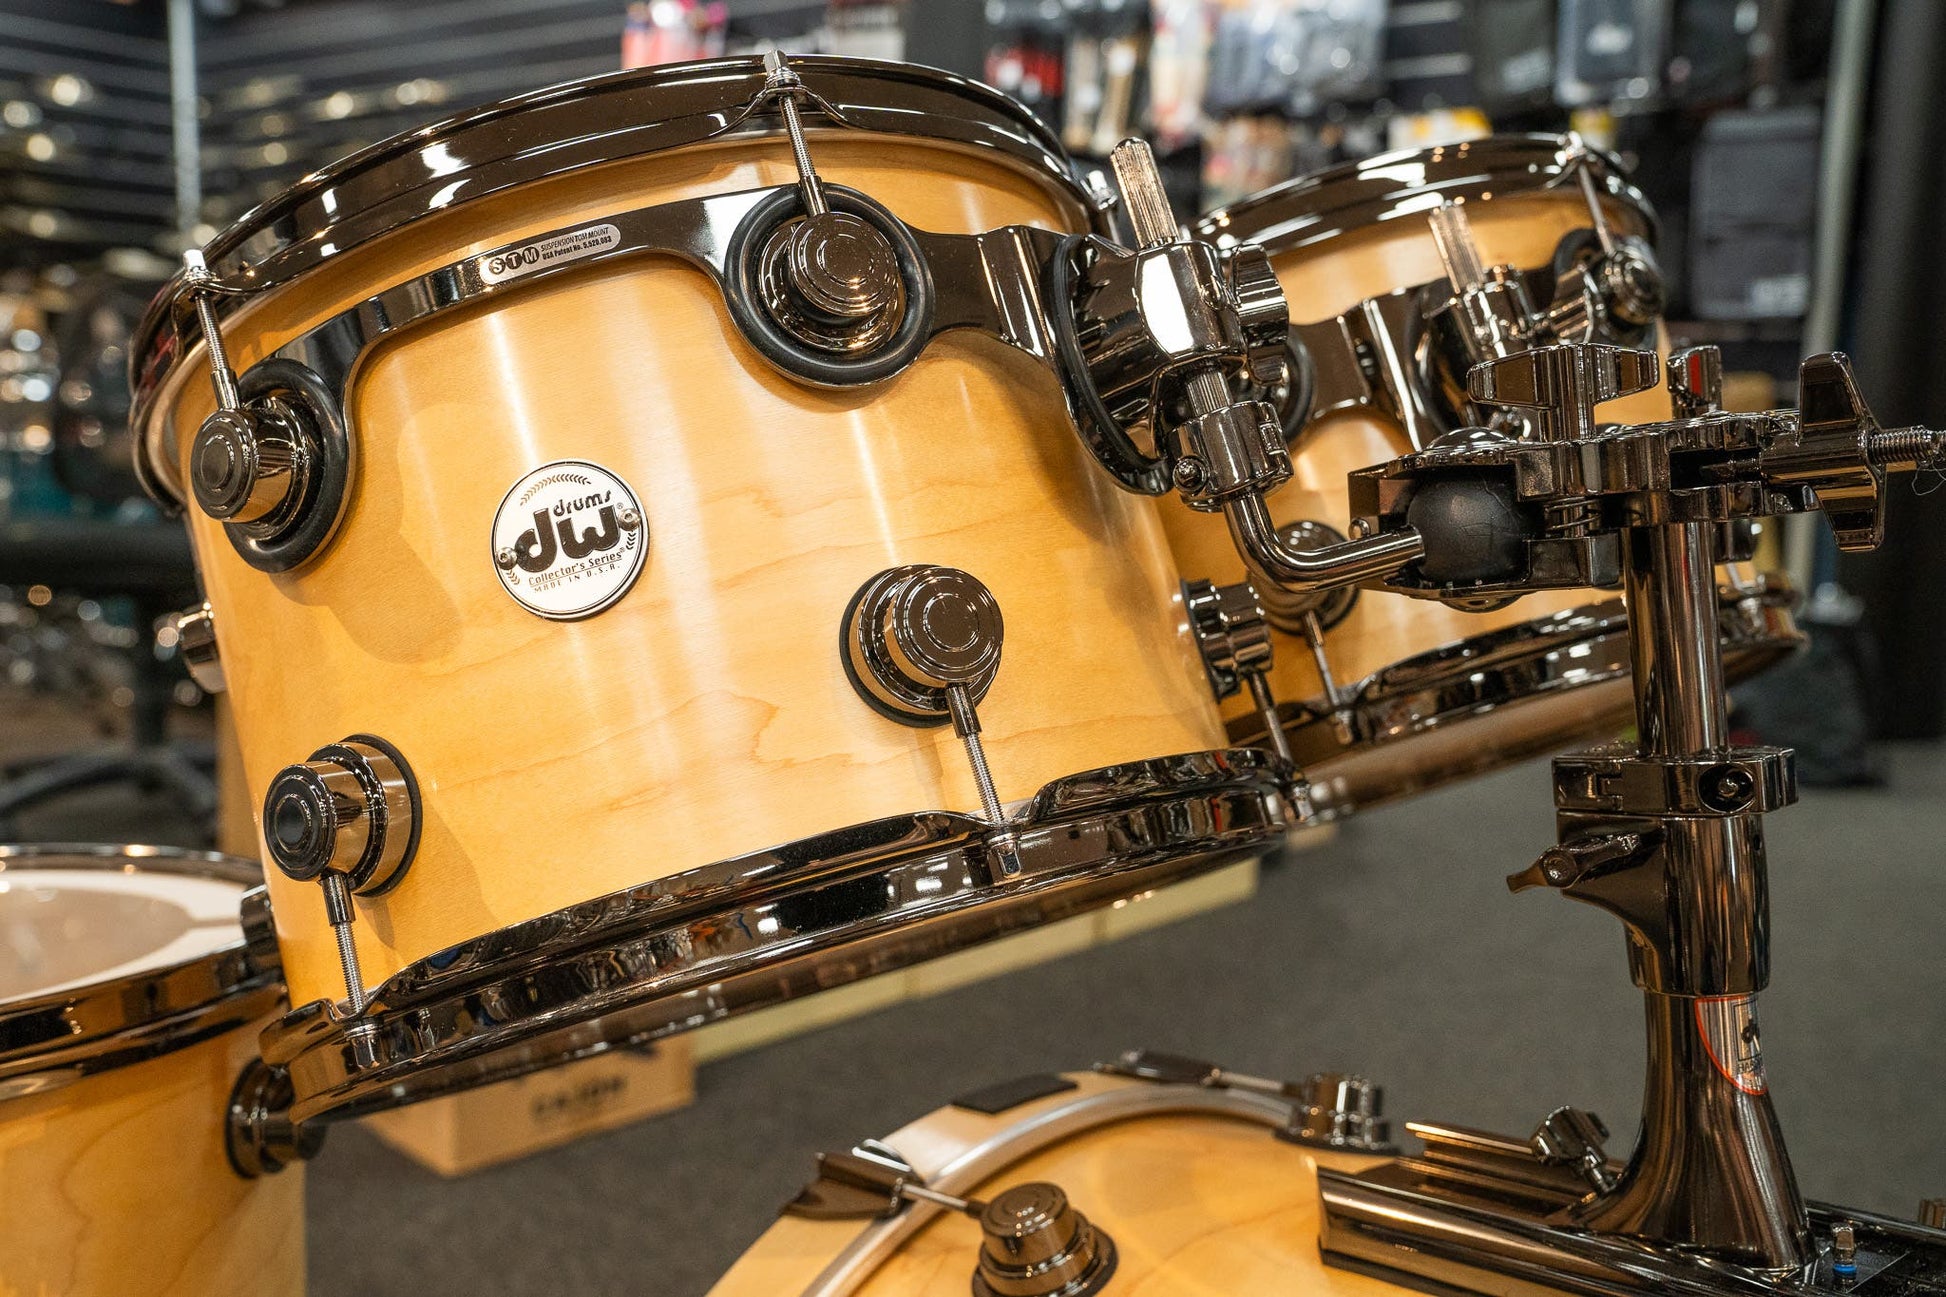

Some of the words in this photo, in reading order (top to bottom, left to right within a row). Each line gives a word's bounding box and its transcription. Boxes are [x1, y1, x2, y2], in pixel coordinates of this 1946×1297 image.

[541, 235, 575, 251] SUSPENSION
[575, 233, 588, 242] TOM
[588, 227, 609, 239] MOUNT
[489, 247, 540, 275] STM
[542, 251, 554, 260] USA
[554, 246, 573, 257] Patent
[573, 243, 583, 251] No.
[553, 489, 612, 517] drums
[528, 561, 586, 586] Collector's
[534, 581, 562, 593] MADE
[569, 574, 581, 584] IN
